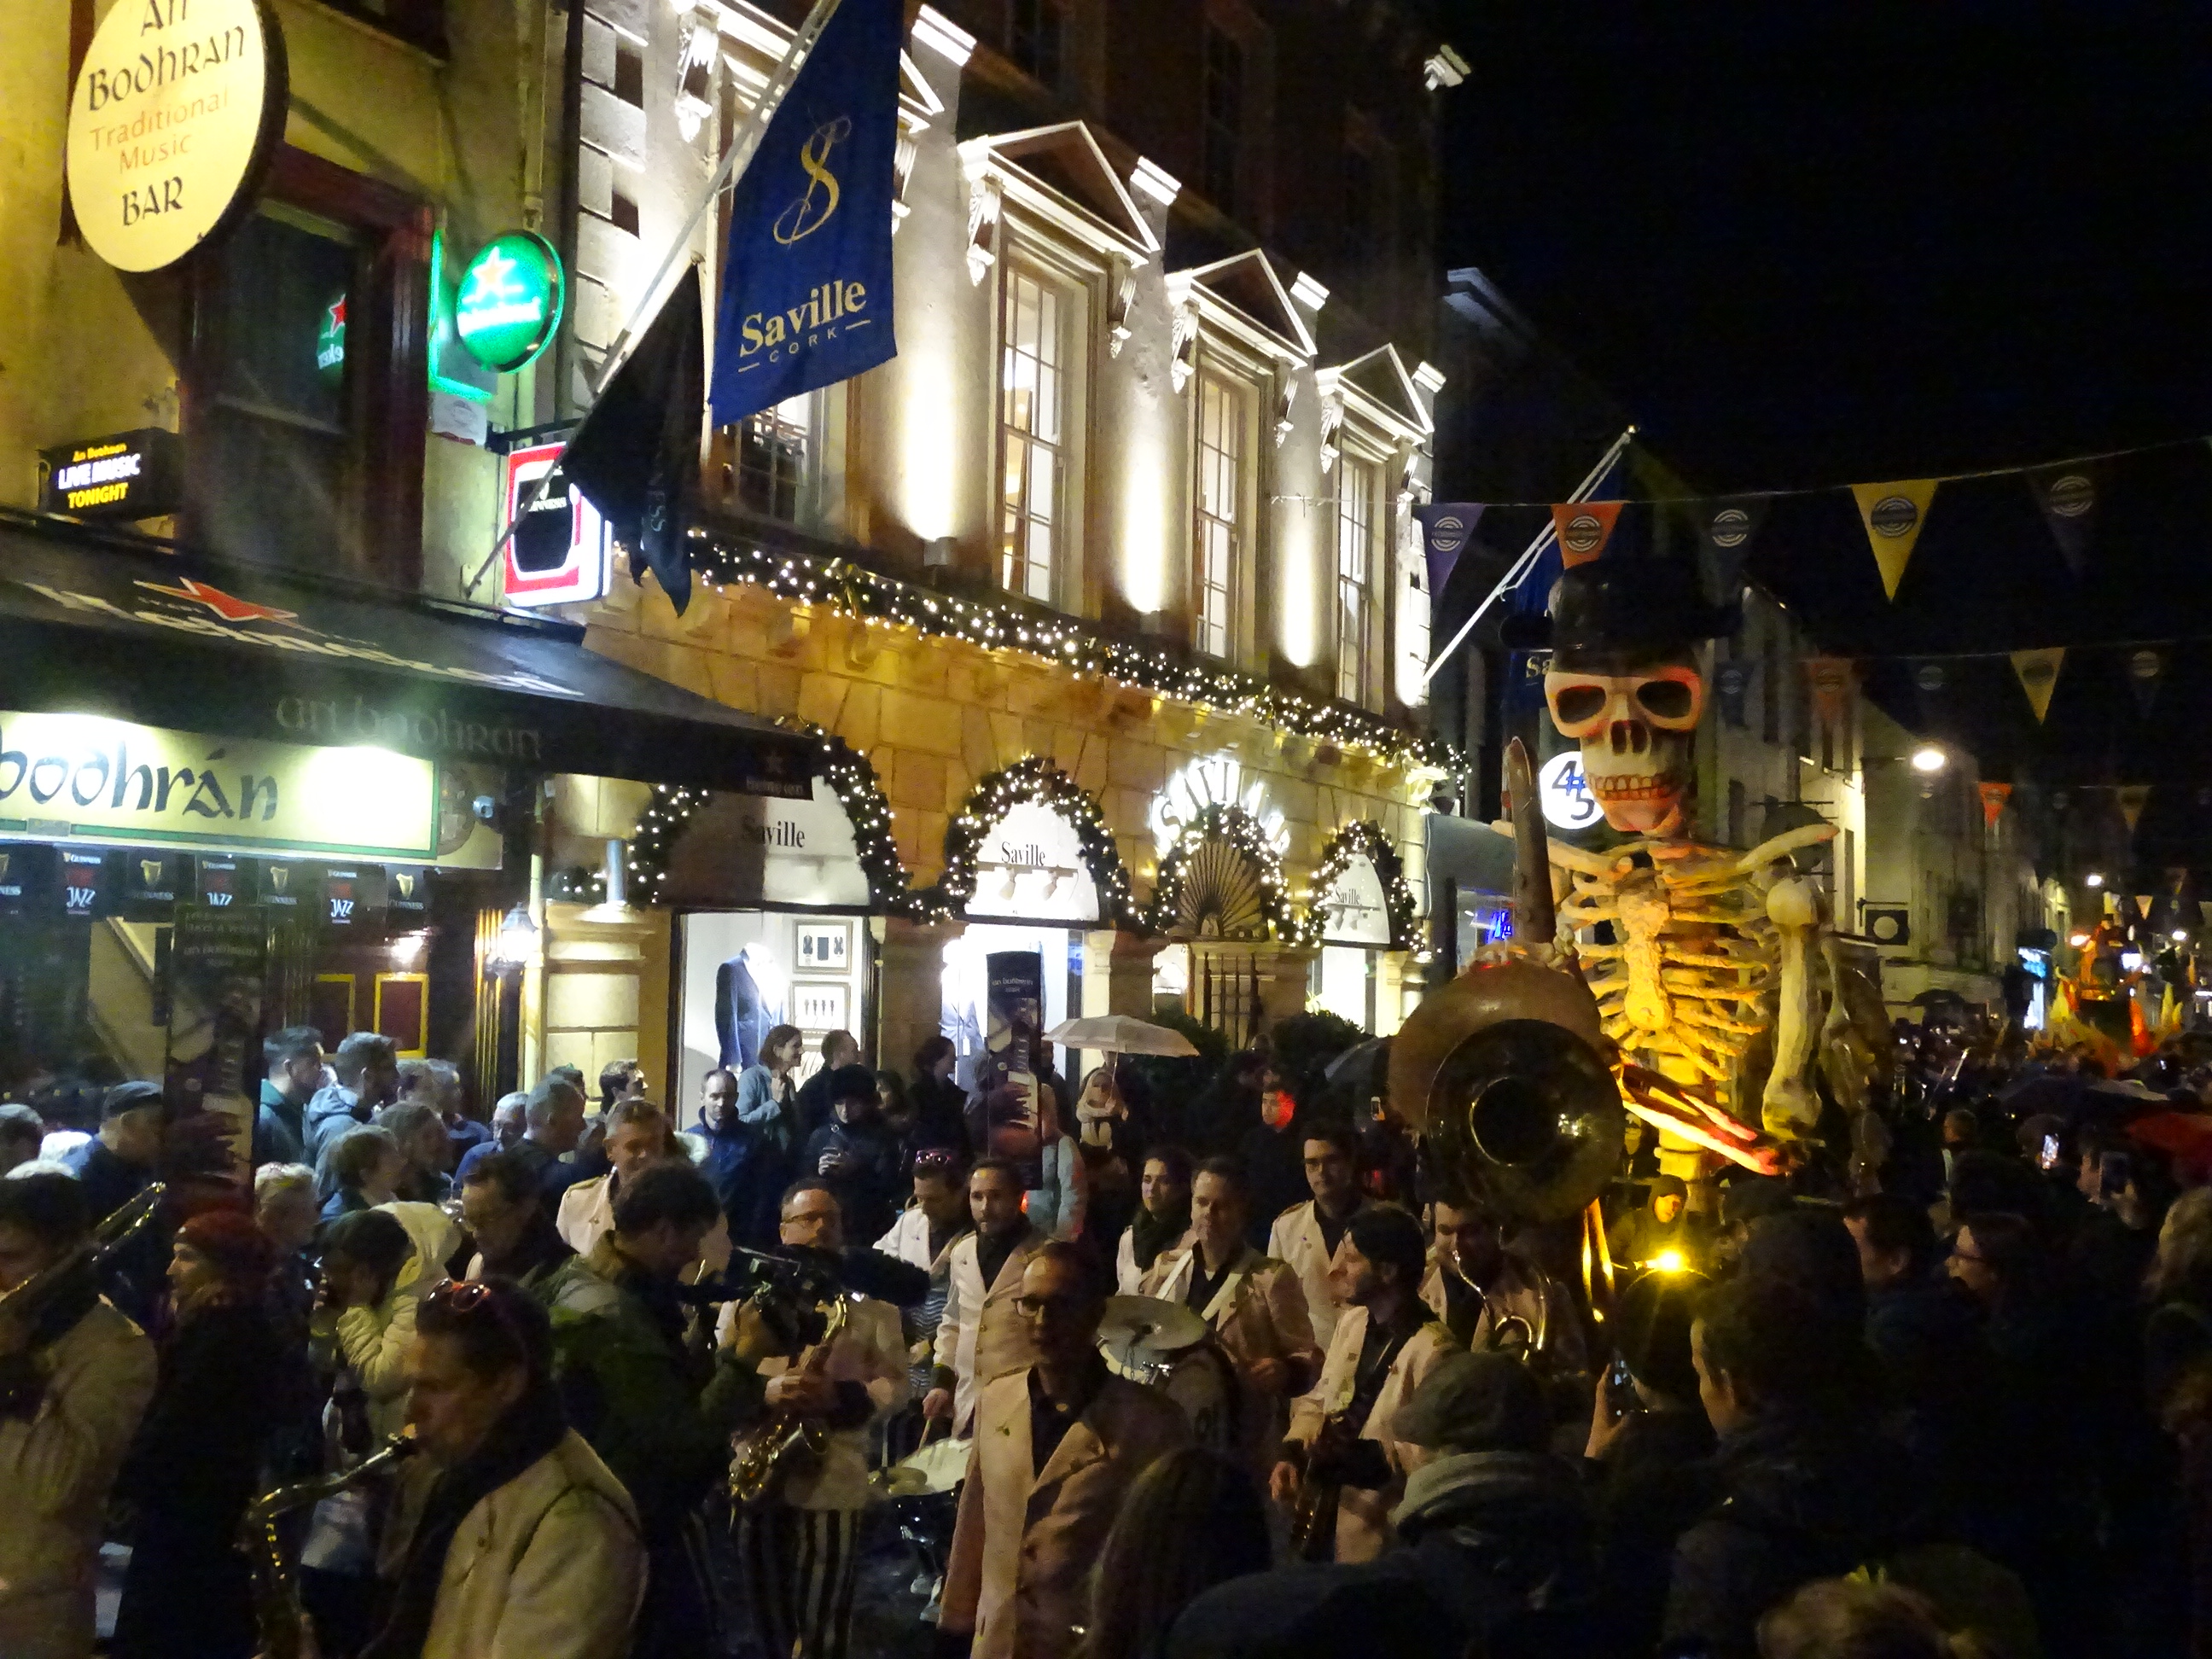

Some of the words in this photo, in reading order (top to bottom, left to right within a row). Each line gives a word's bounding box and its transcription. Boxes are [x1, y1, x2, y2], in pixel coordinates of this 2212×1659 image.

[90, 84, 228, 151] Traditional
[119, 134, 193, 174] Music
[122, 176, 183, 226] BAR
[739, 279, 867, 358] Saville
[769, 327, 837, 363] CORK
[58, 463, 91, 490] LIVE
[68, 482, 128, 509] TONIGHT
[742, 814, 806, 847] Saville
[1001, 841, 1045, 866] Saville
[67, 886, 96, 908] JAZZ
[207, 892, 232, 906] JAZZ
[330, 899, 354, 917] JAZZ
[1335, 887, 1361, 905] Saville
